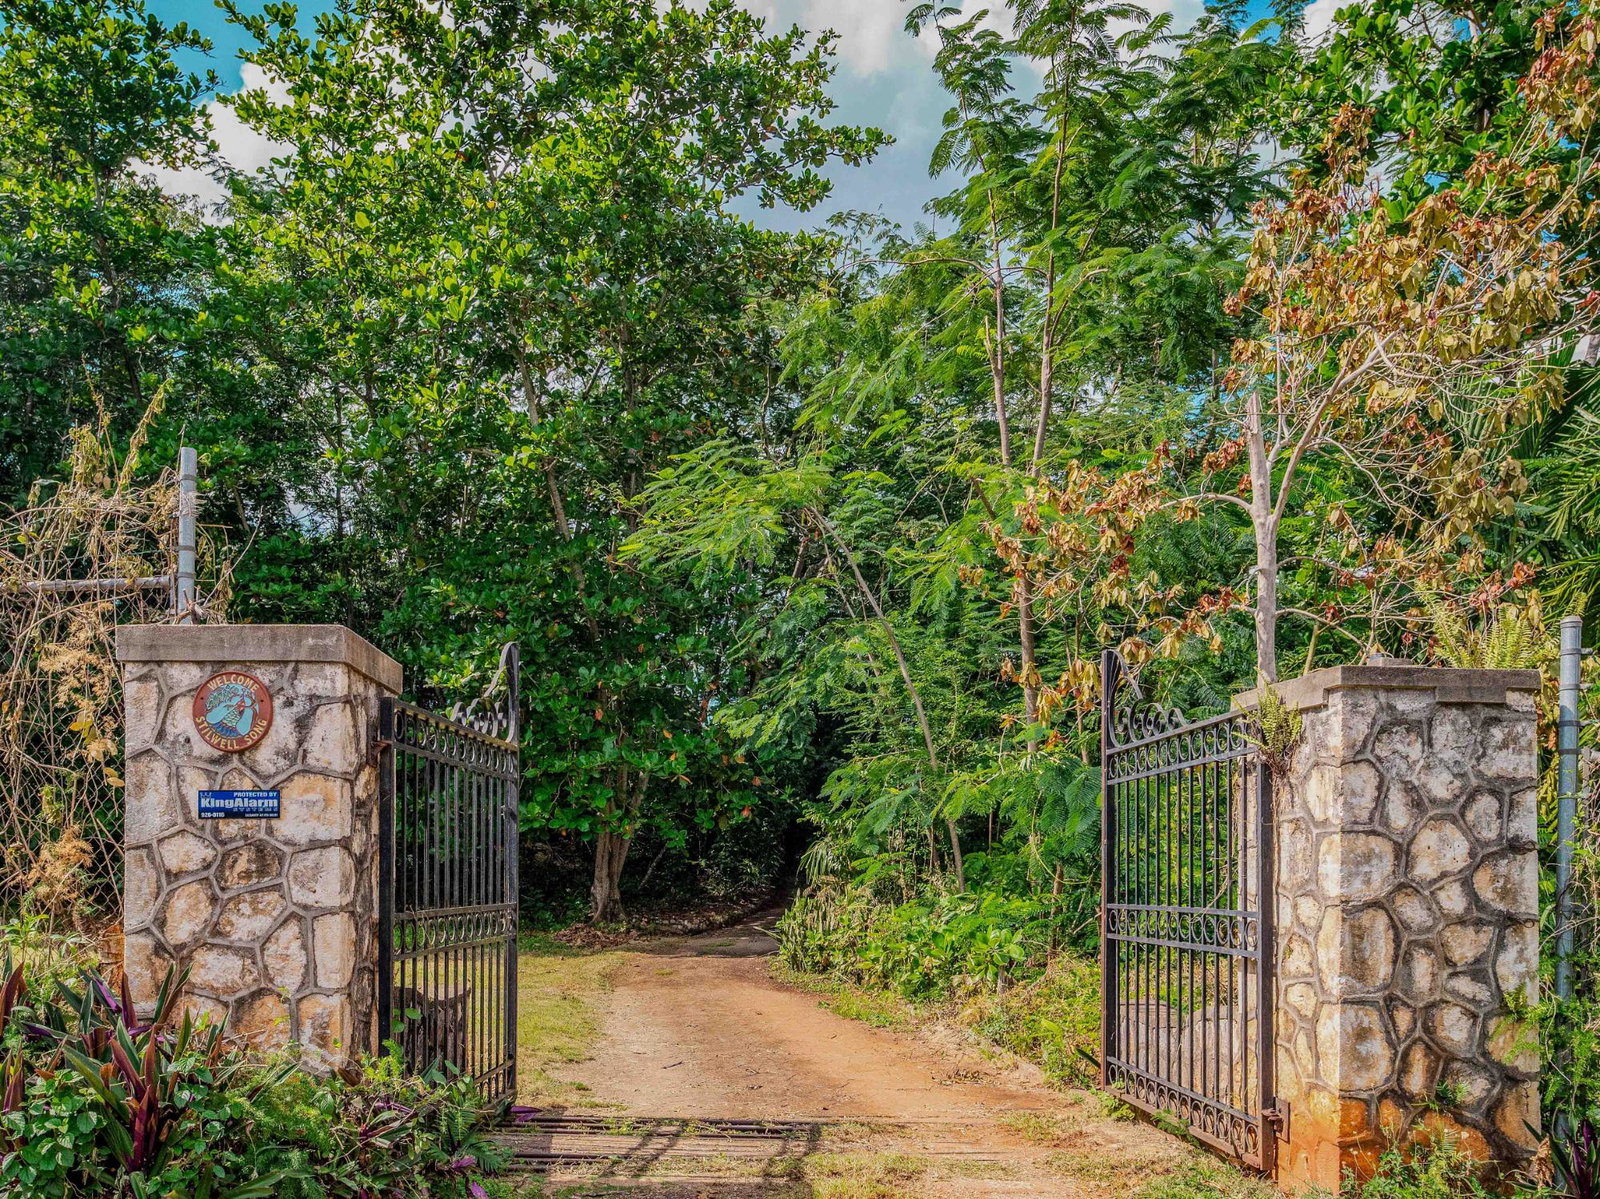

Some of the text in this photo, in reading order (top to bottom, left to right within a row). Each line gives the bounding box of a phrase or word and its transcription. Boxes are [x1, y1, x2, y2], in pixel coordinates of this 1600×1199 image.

[207, 674, 260, 693] WELCOME
[195, 716, 267, 750] STILWELL SONG
[201, 798, 278, 808] KingAlarm
